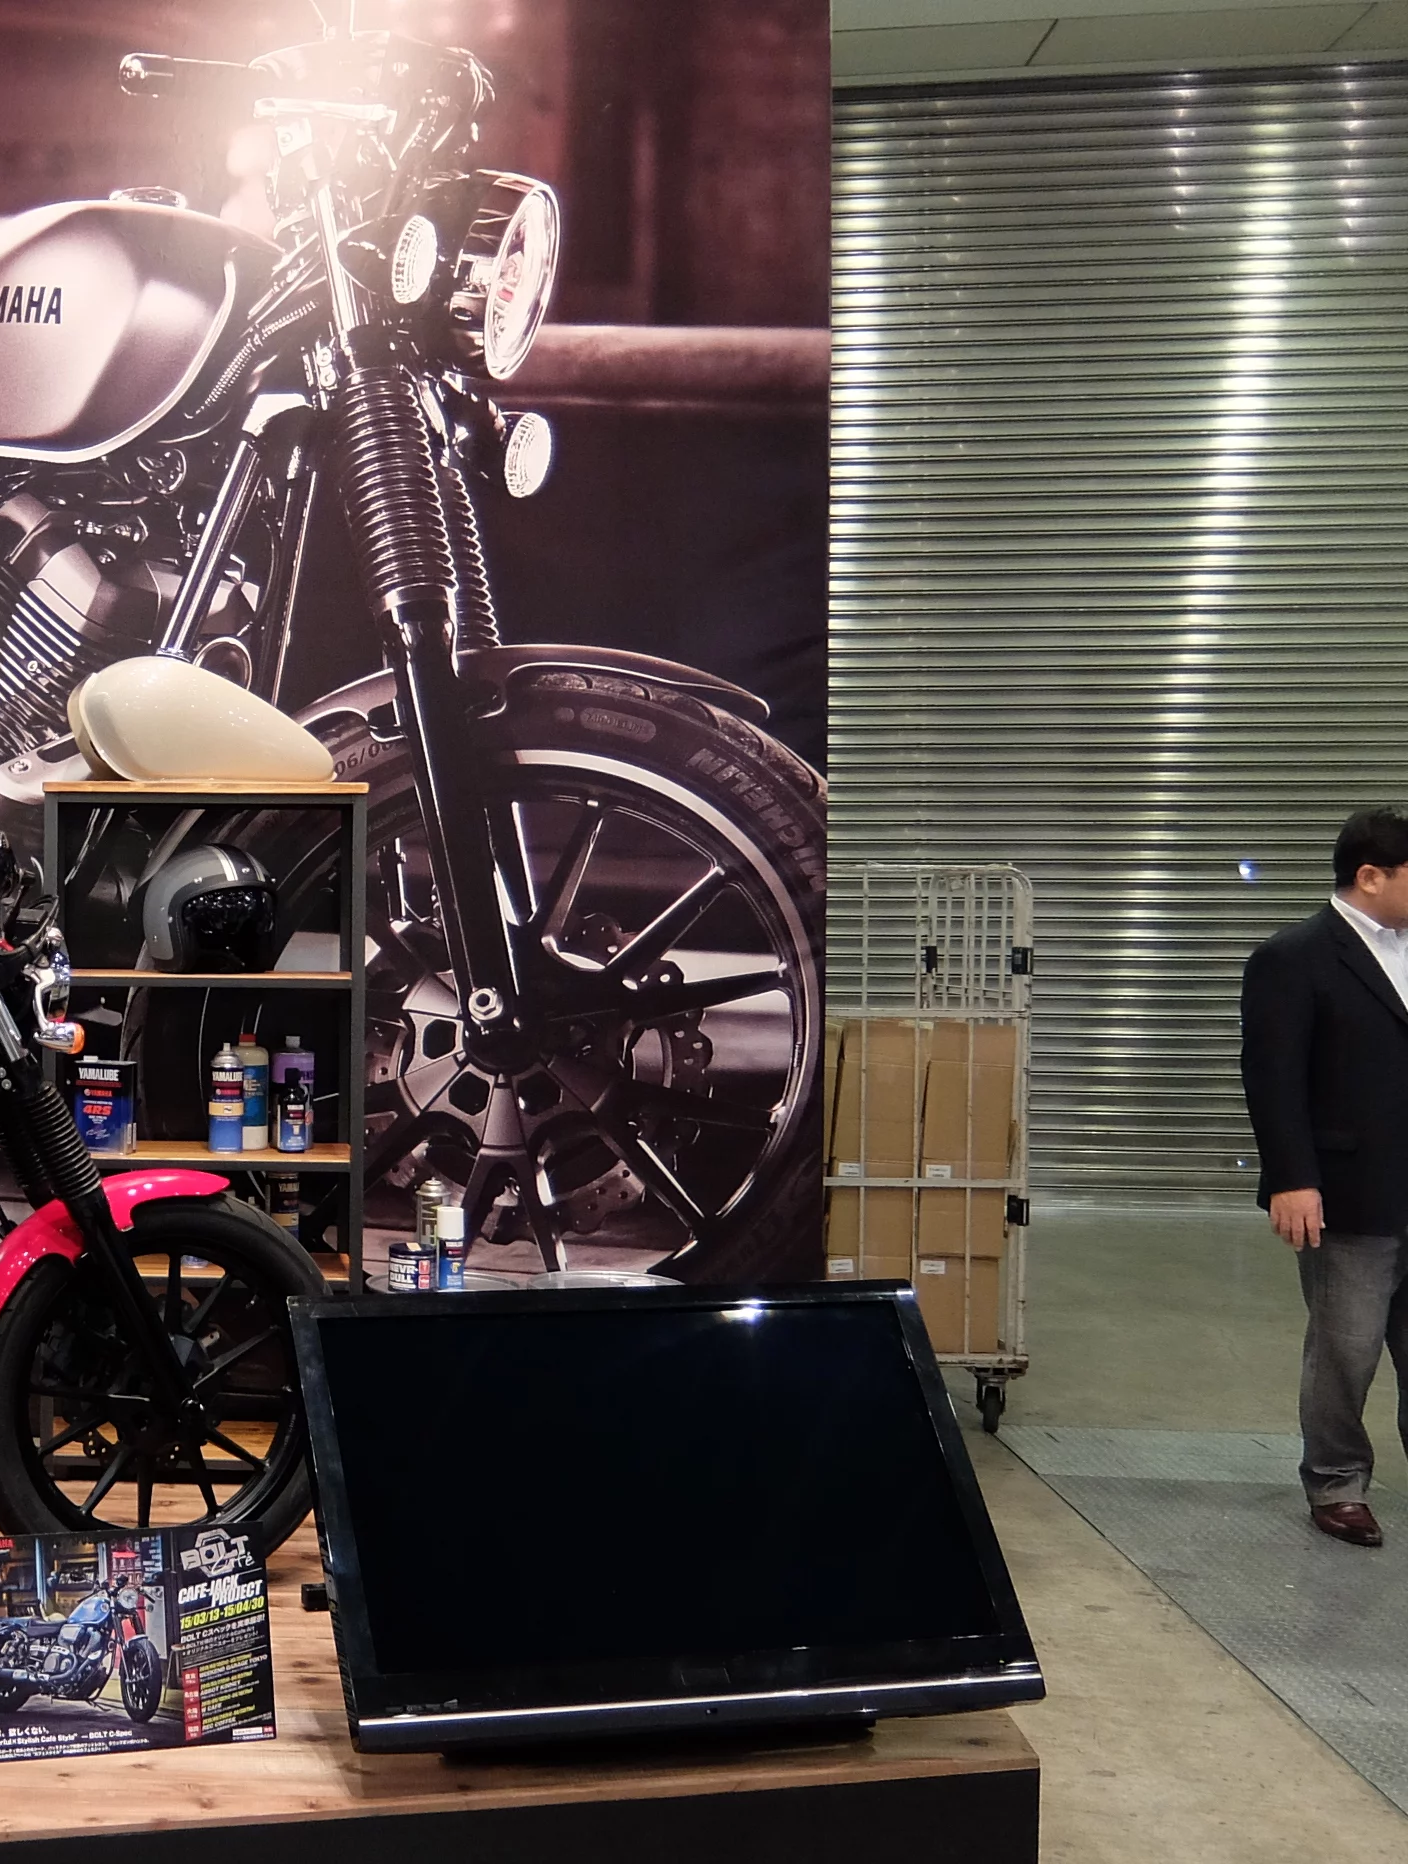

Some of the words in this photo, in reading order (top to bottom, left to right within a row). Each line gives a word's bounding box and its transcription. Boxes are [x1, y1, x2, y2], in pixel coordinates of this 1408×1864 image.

[78, 1067, 120, 1082] YAMALUBE
[82, 1104, 112, 1116] 4RS
[180, 1535, 249, 1571] BOLT
[178, 1574, 240, 1605] CAFE-JACK
[211, 1579, 263, 1608] PROJECT
